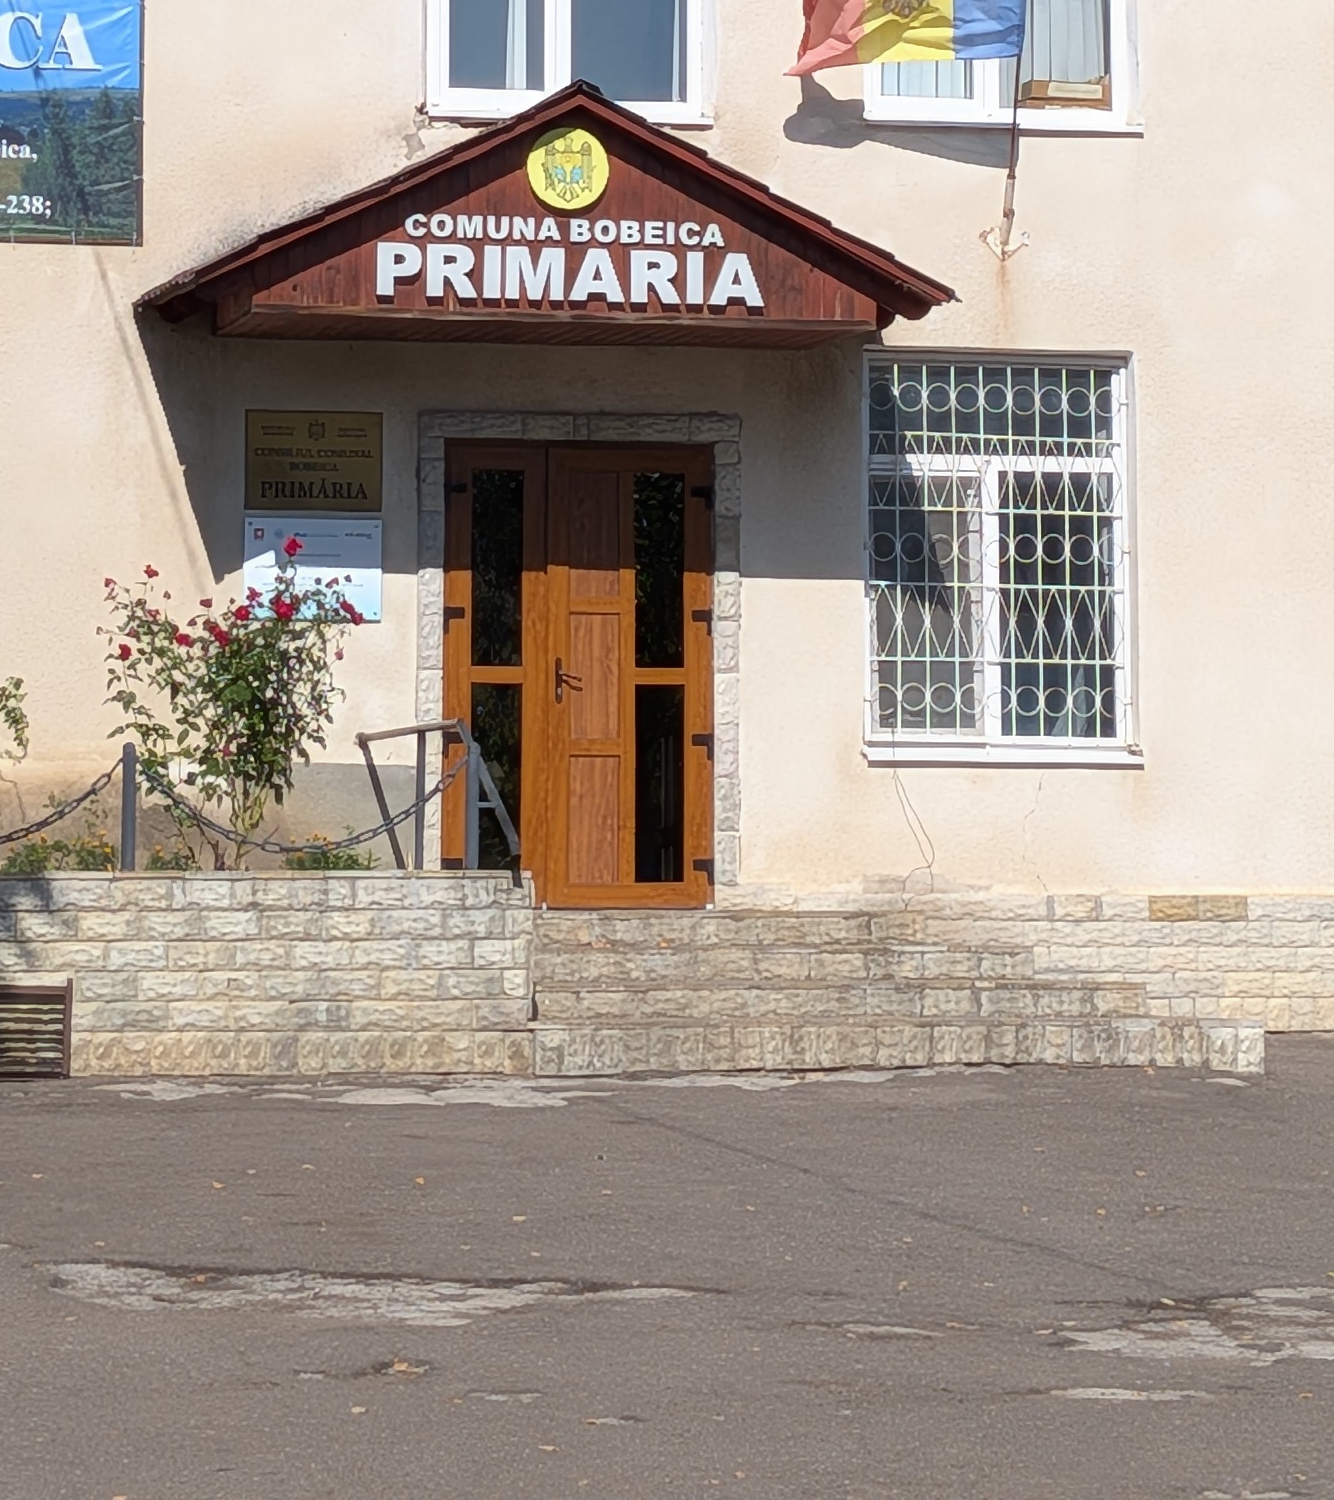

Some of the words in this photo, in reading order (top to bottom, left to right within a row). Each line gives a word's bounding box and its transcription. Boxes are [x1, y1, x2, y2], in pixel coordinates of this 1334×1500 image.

[404, 214, 561, 241] COMUNA
[569, 219, 725, 247] BOBEICA
[375, 241, 765, 308] PRIMARIA
[260, 478, 368, 500] PRIMĂRIA
